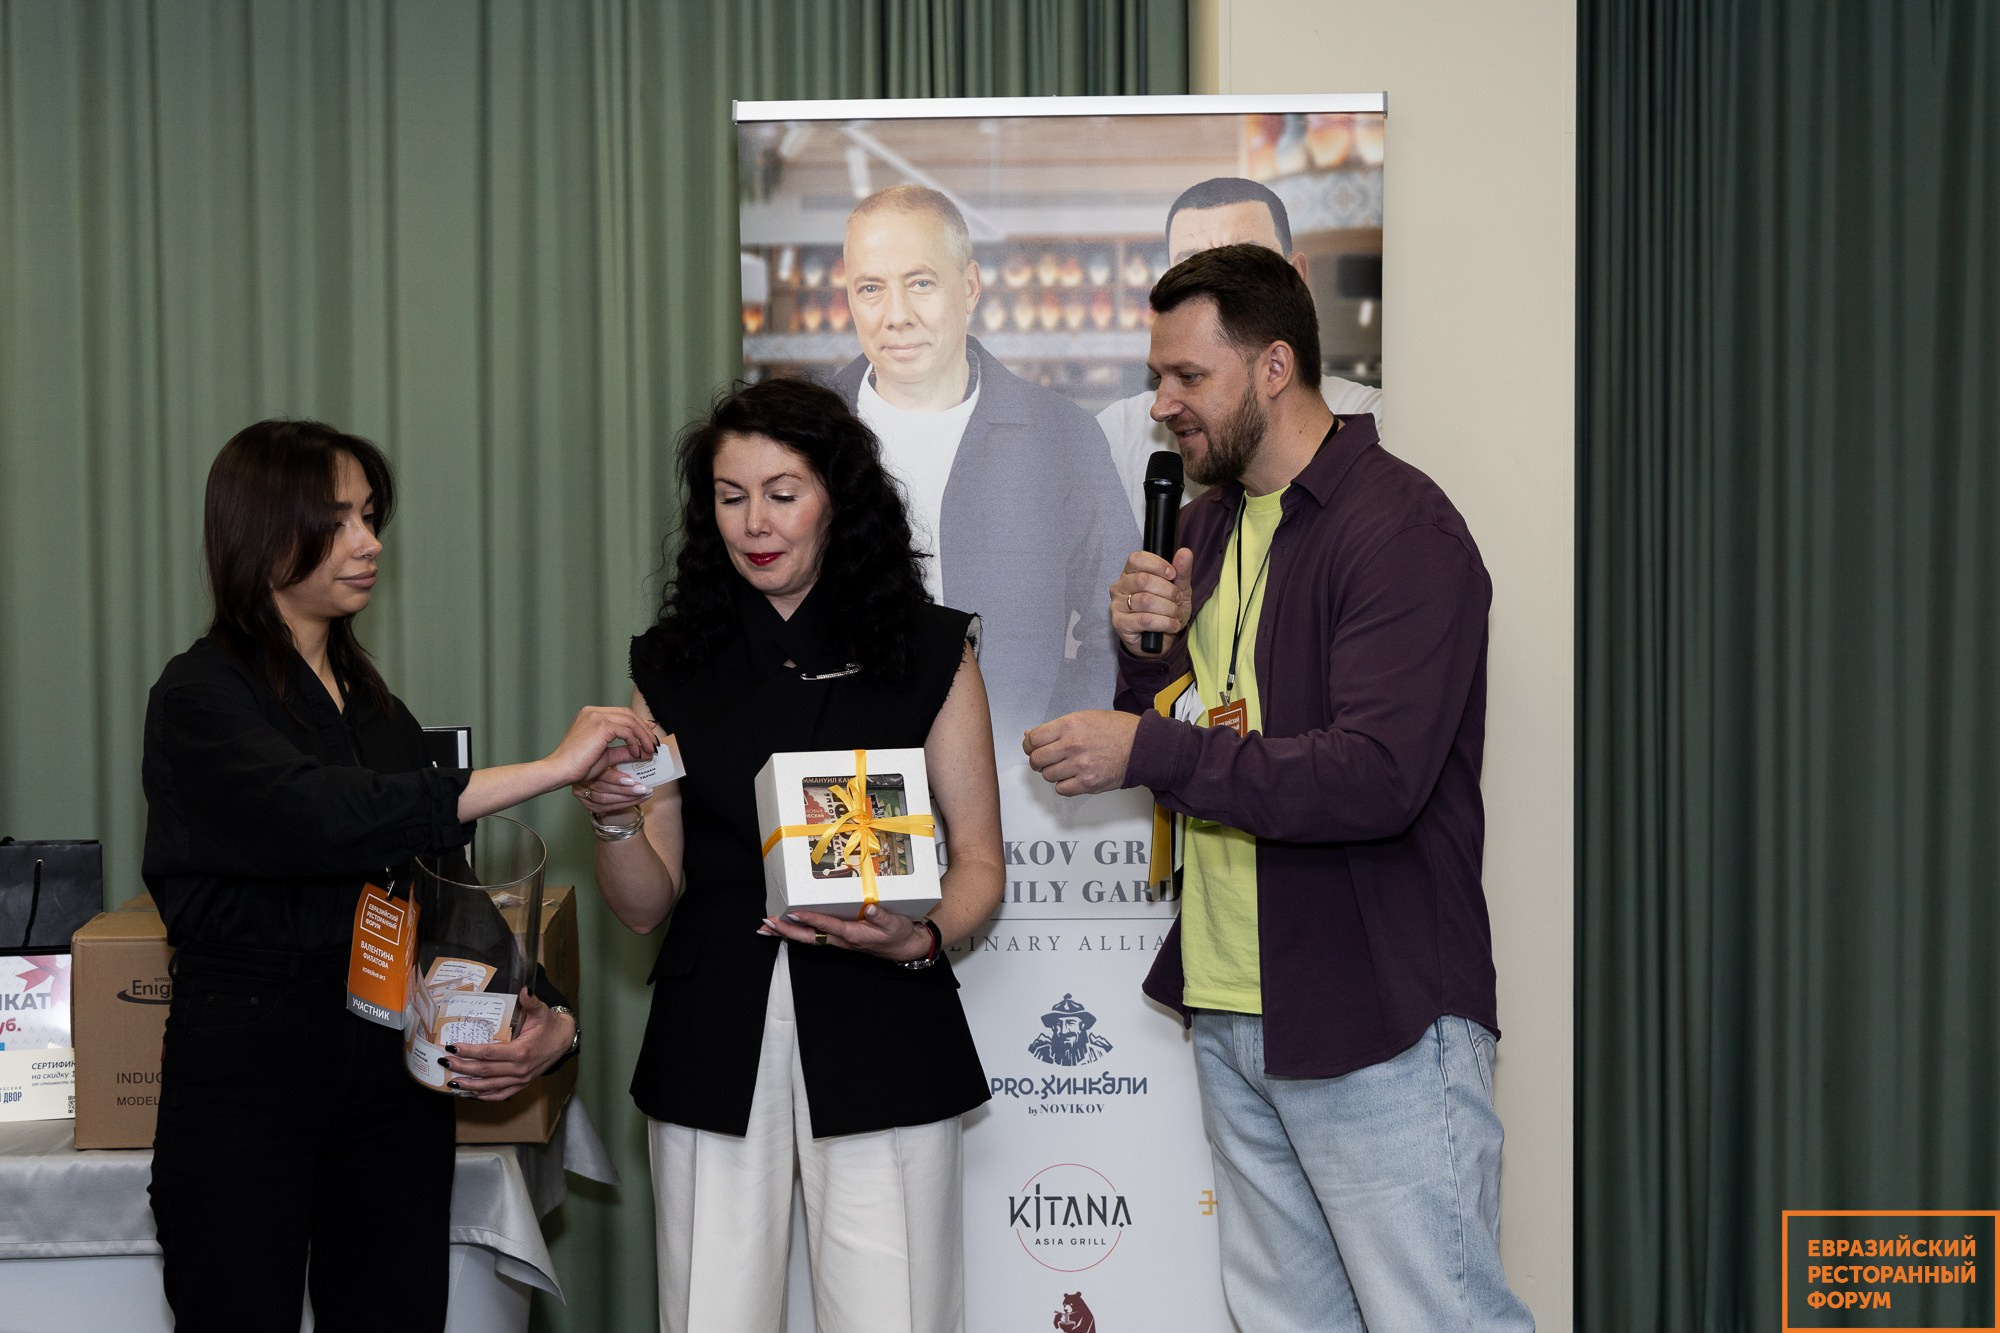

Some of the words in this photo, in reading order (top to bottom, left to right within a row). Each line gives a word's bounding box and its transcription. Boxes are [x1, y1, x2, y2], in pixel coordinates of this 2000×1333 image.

[1001, 881, 1069, 904] ILY
[360, 940, 394, 962] ВАЛЕНТИНА
[363, 952, 389, 969] ФИЛАТОВА
[132, 980, 171, 998] Enig
[352, 997, 390, 1020] УЧАСТНИК
[43, 1071, 69, 1079] скидку
[3, 1091, 22, 1104] ДВОР
[117, 1096, 161, 1106] MODEL
[1028, 1106, 1038, 1116] by
[1040, 1104, 1105, 1114] NOVIKOV
[1035, 1238, 1064, 1246] ASIA
[1070, 1238, 1107, 1246] GRILL
